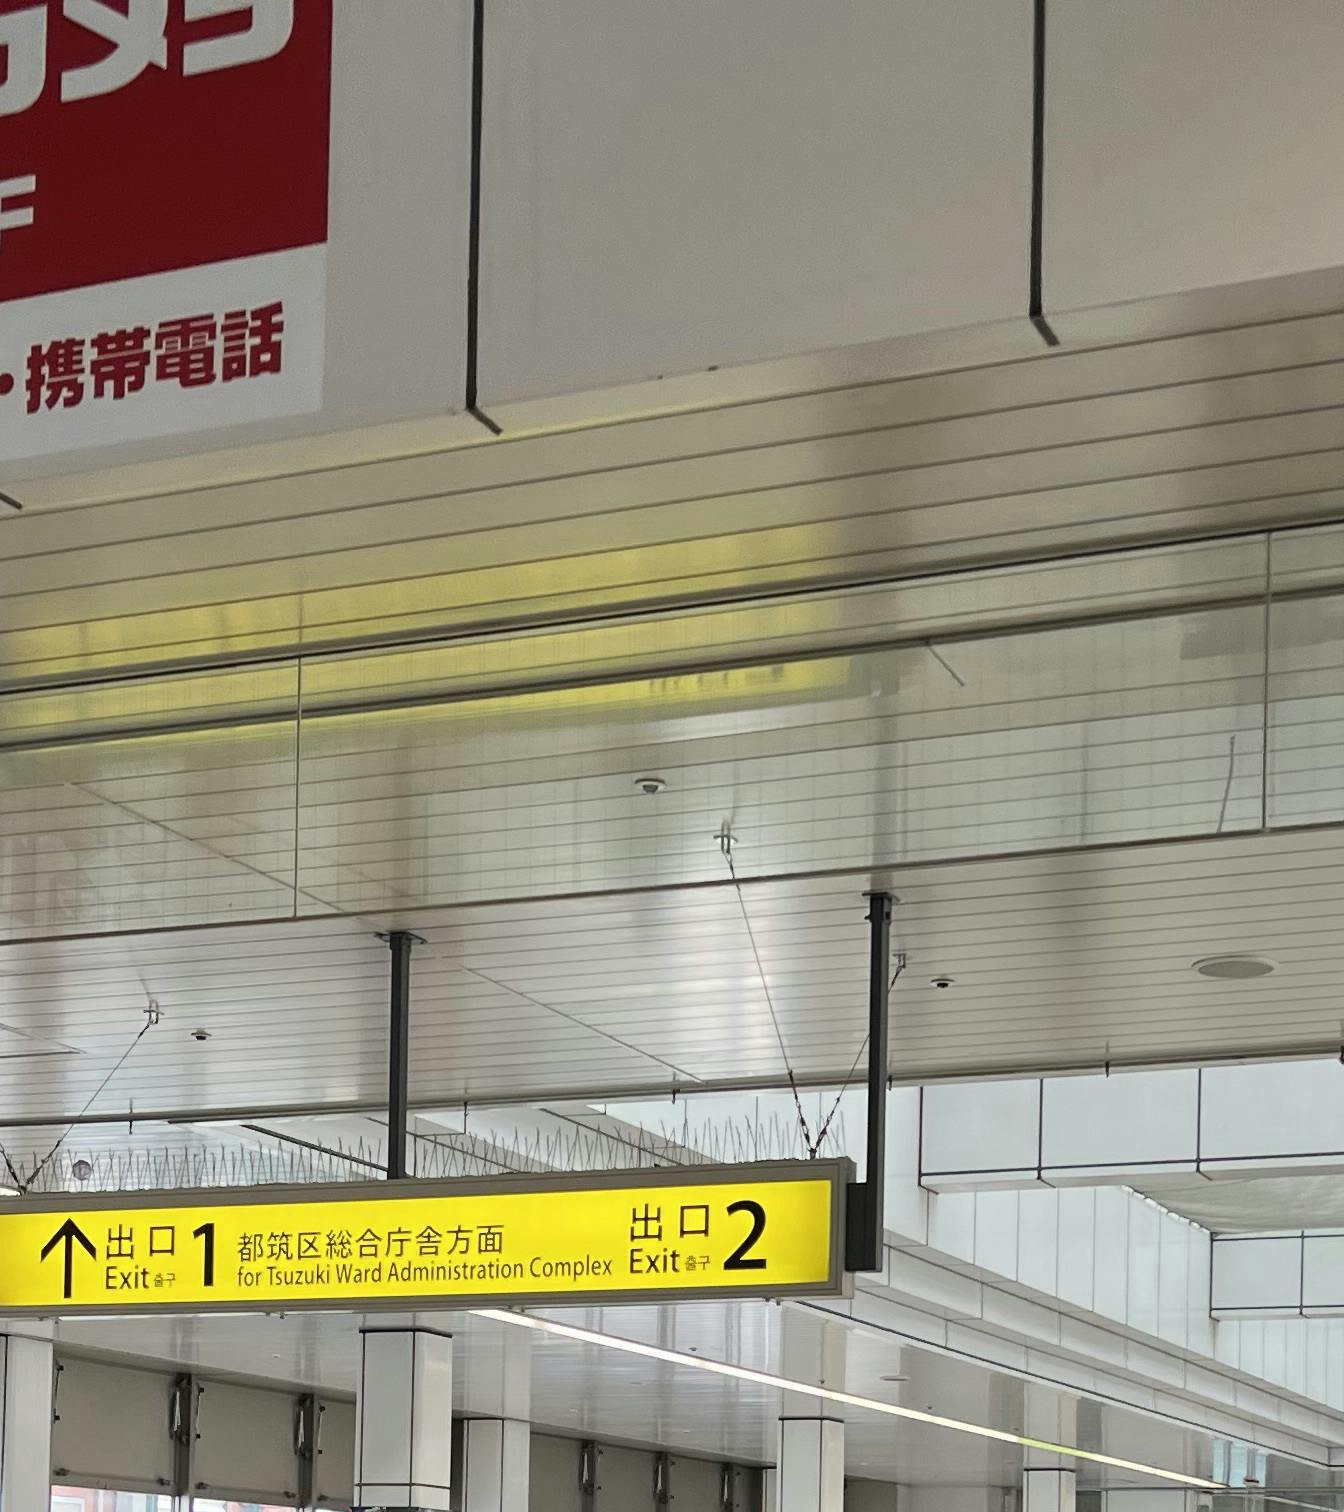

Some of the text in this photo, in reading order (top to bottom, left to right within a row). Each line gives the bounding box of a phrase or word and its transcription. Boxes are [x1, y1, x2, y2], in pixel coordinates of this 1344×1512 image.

[237, 1224, 505, 1263] 都筑区総合庁舎方面
[630, 1200, 767, 1270] 出口 2
[106, 1223, 214, 1287] 出口 1
[237, 1254, 613, 1288] for Tsuzuki Ward Administration Complex
[630, 1248, 680, 1274] Exit
[106, 1265, 149, 1289] Exit
